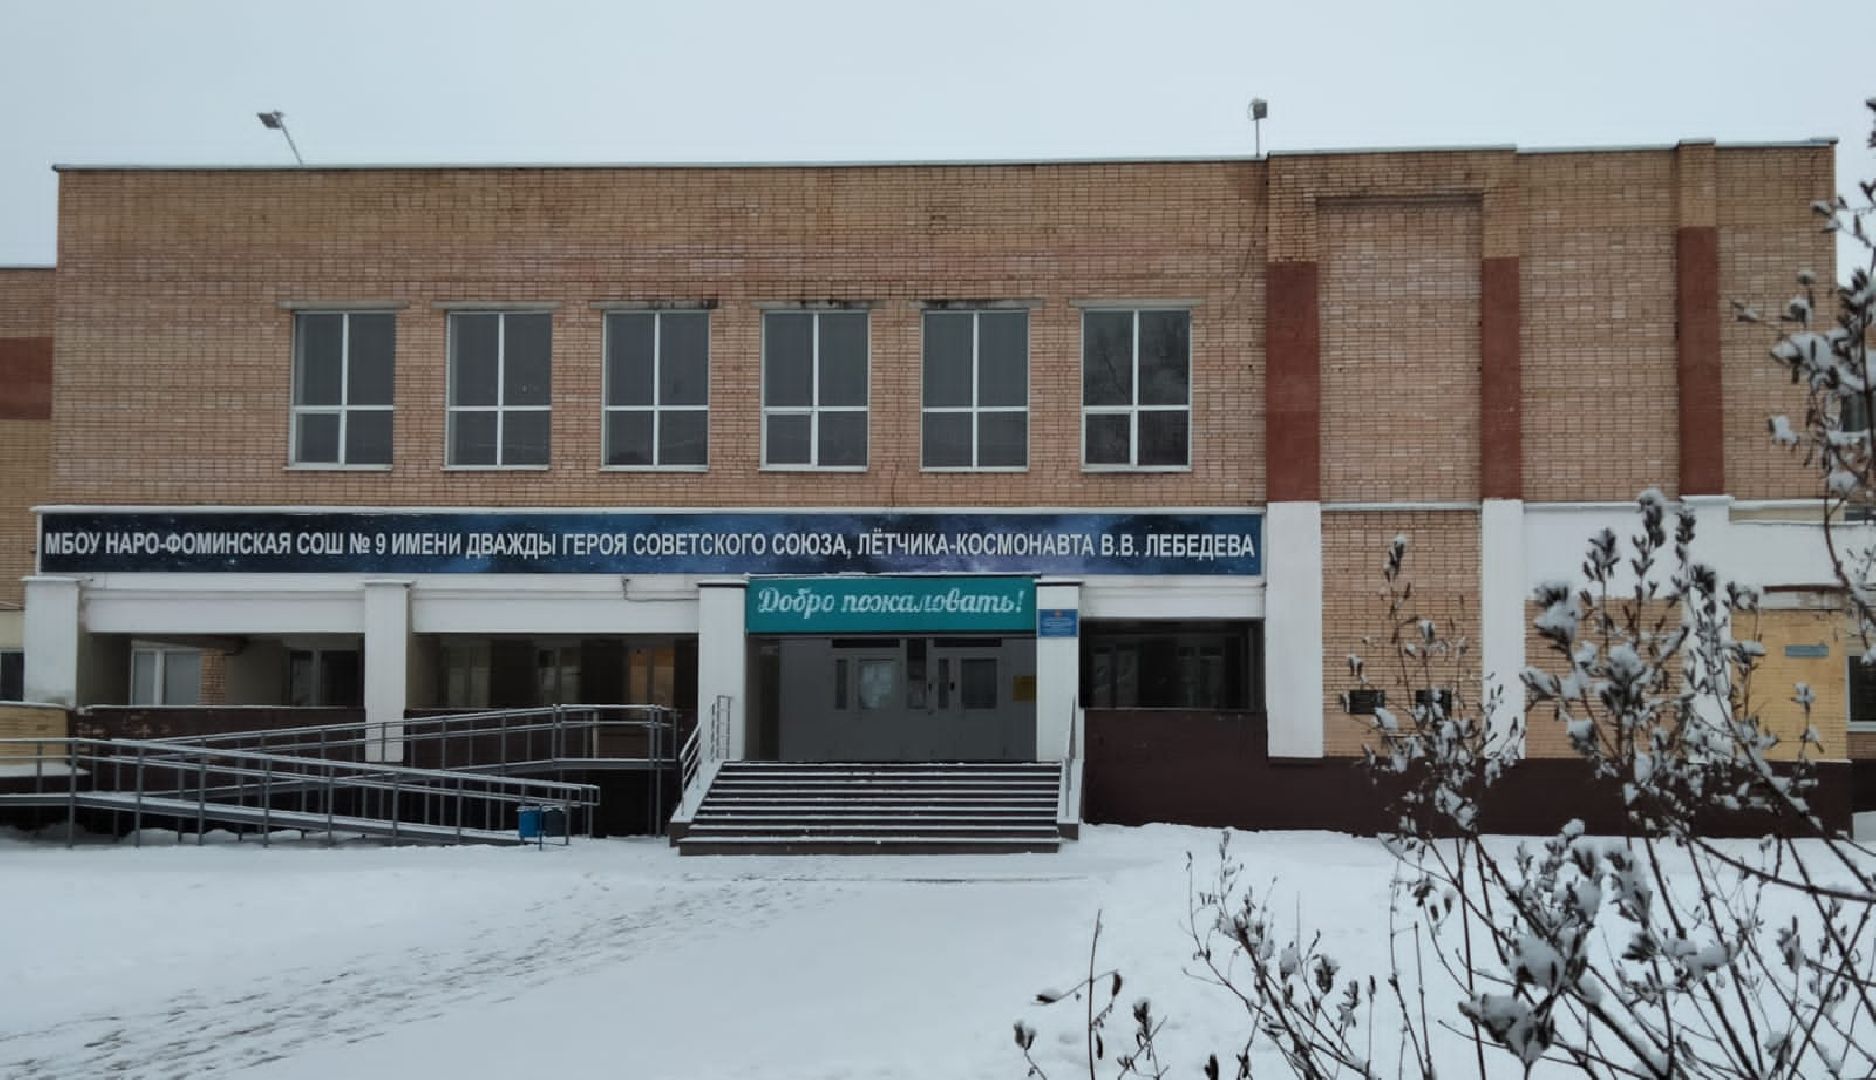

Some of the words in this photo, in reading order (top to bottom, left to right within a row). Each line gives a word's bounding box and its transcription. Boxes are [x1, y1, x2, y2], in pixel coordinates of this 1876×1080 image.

[45, 532, 100, 555] МБОУ
[106, 532, 291, 555] НАРО-ФОМИНСКАЯ
[297, 532, 343, 555] СОШ
[349, 532, 370, 555] №
[376, 532, 386, 555] 9
[392, 532, 461, 555] ИМЕНИ
[466, 532, 556, 559] ДВАЖДЫ
[562, 532, 627, 556] ГЕРОЯ
[633, 532, 766, 556] СОВЕТСКОГО
[772, 532, 852, 559] СОЮЗА,
[857, 527, 1096, 556] ЛЁТЧИКА-КОСМОНАВТА
[1101, 533, 1139, 556] В.В.
[1145, 533, 1255, 560] ЛЕБЕДЕВА
[757, 587, 835, 619] Добро
[839, 589, 1025, 614] пожаловать!
